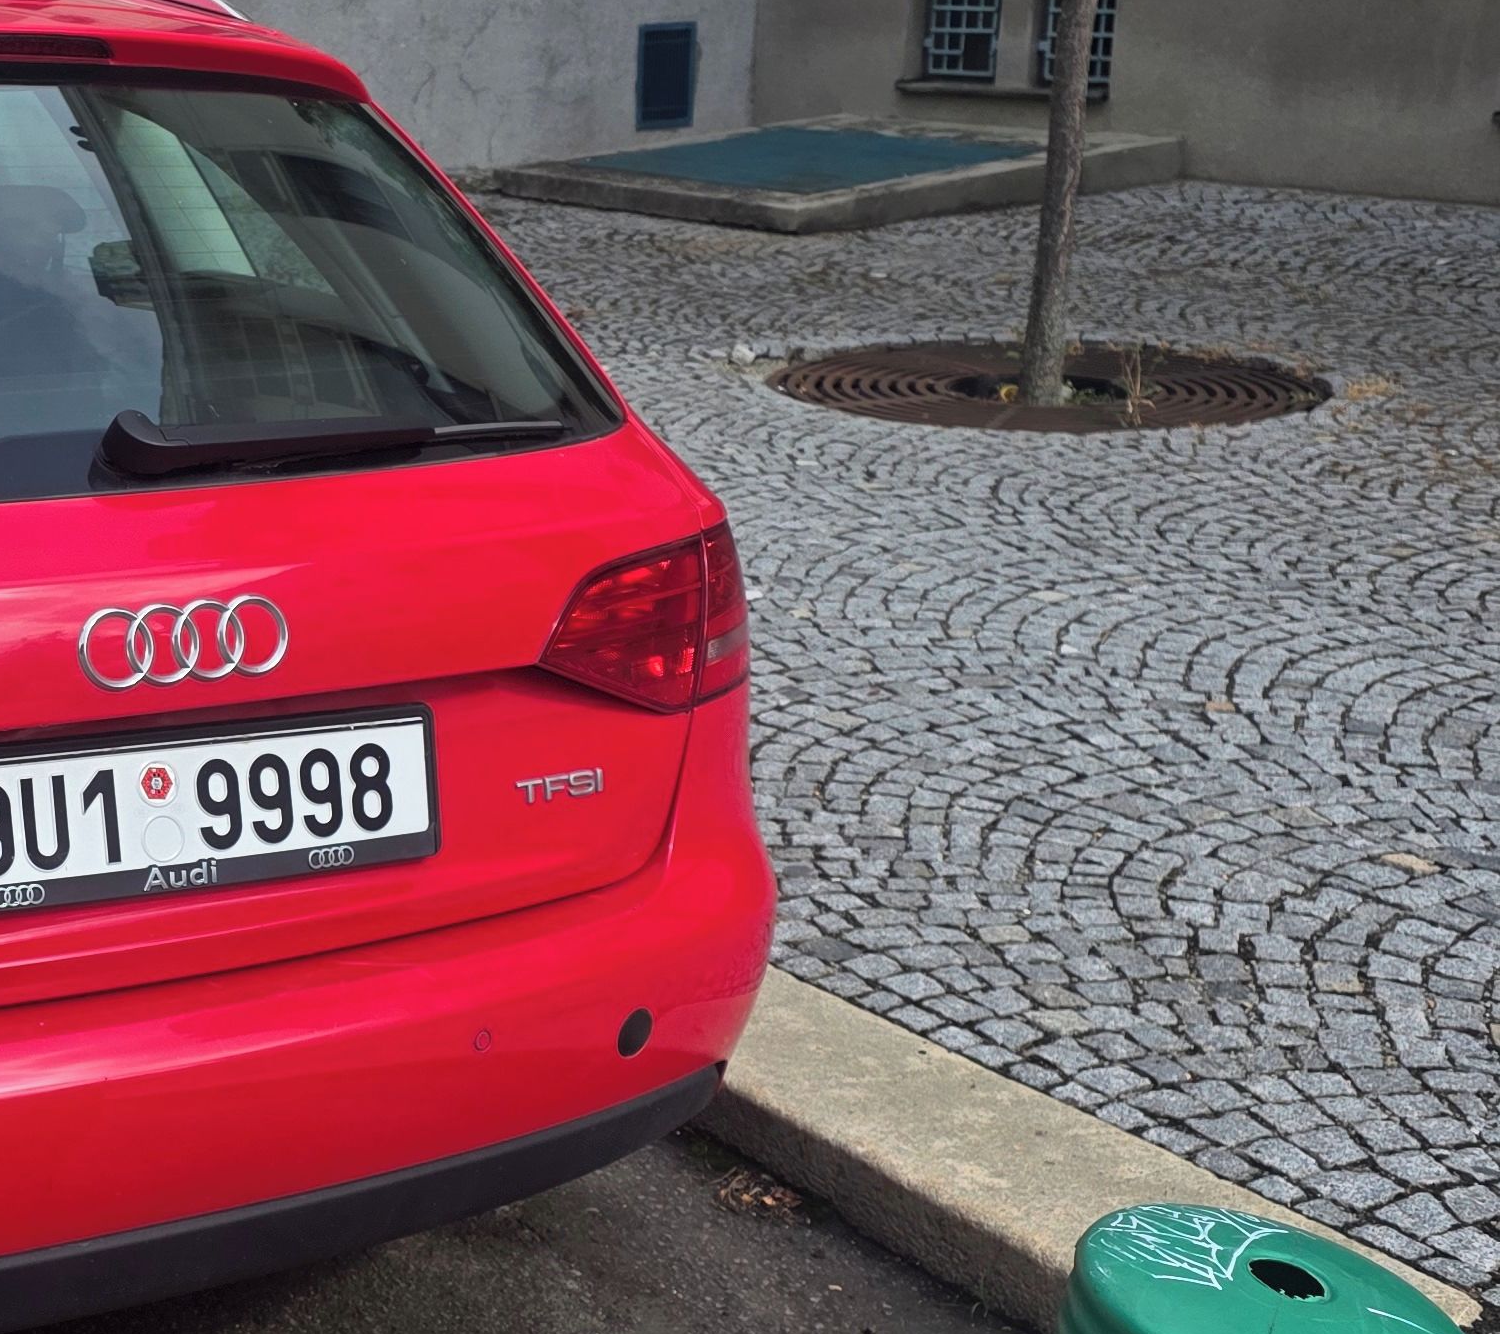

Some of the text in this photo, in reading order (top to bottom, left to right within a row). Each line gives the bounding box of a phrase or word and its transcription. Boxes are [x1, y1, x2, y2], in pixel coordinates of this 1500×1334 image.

[197, 743, 393, 851] 9998
[516, 767, 604, 803] TFSI
[143, 859, 218, 892] Audi
